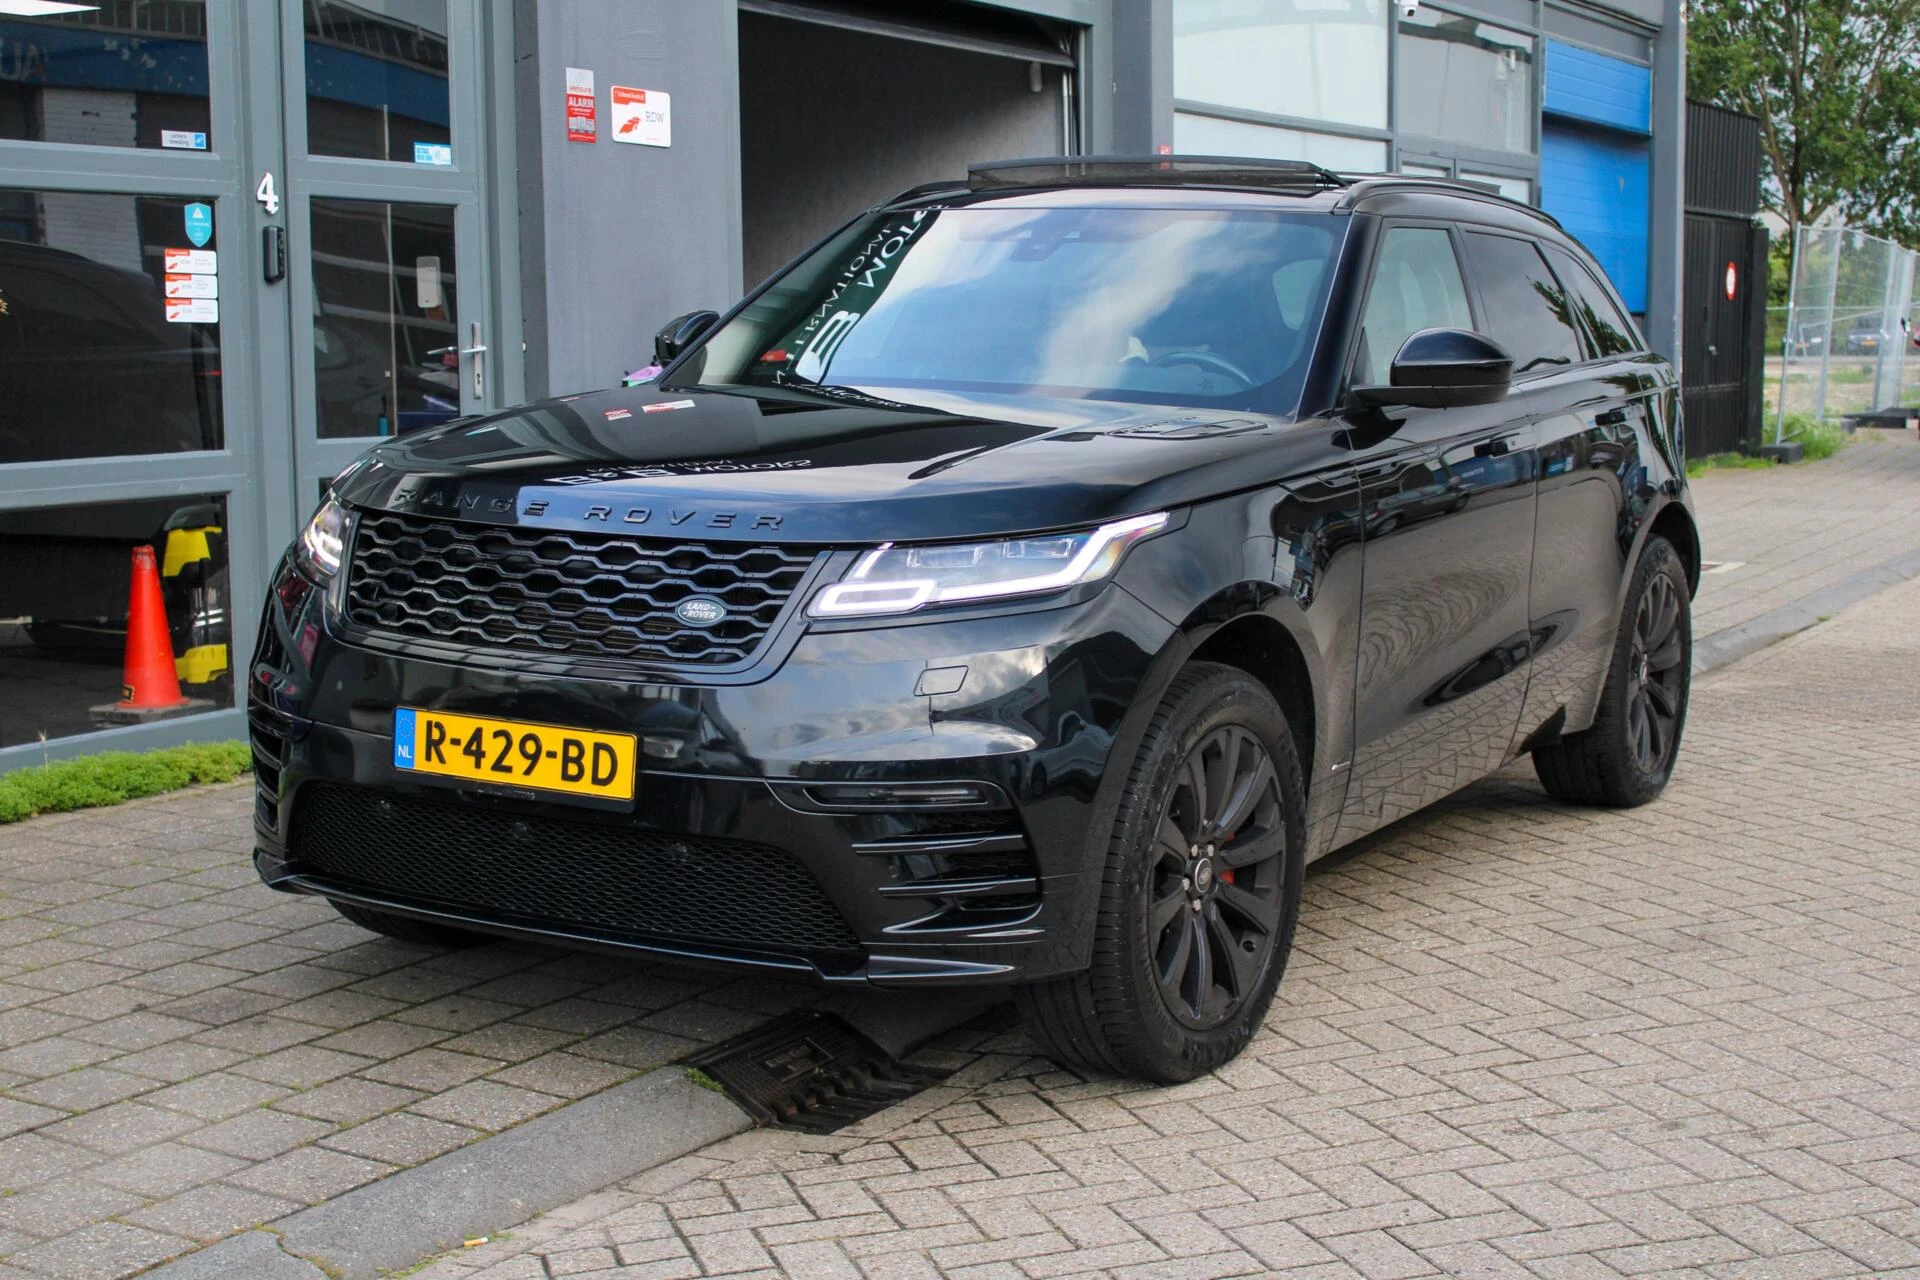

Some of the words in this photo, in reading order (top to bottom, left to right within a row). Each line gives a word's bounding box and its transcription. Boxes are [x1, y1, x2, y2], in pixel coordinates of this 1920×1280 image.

[568, 96, 594, 109] ALARM
[645, 111, 665, 123] RDW
[256, 171, 279, 214] 4
[395, 488, 550, 517] RANGE
[583, 504, 784, 530] ROVER
[397, 744, 413, 759] NL
[424, 719, 619, 787] R-429-BD
